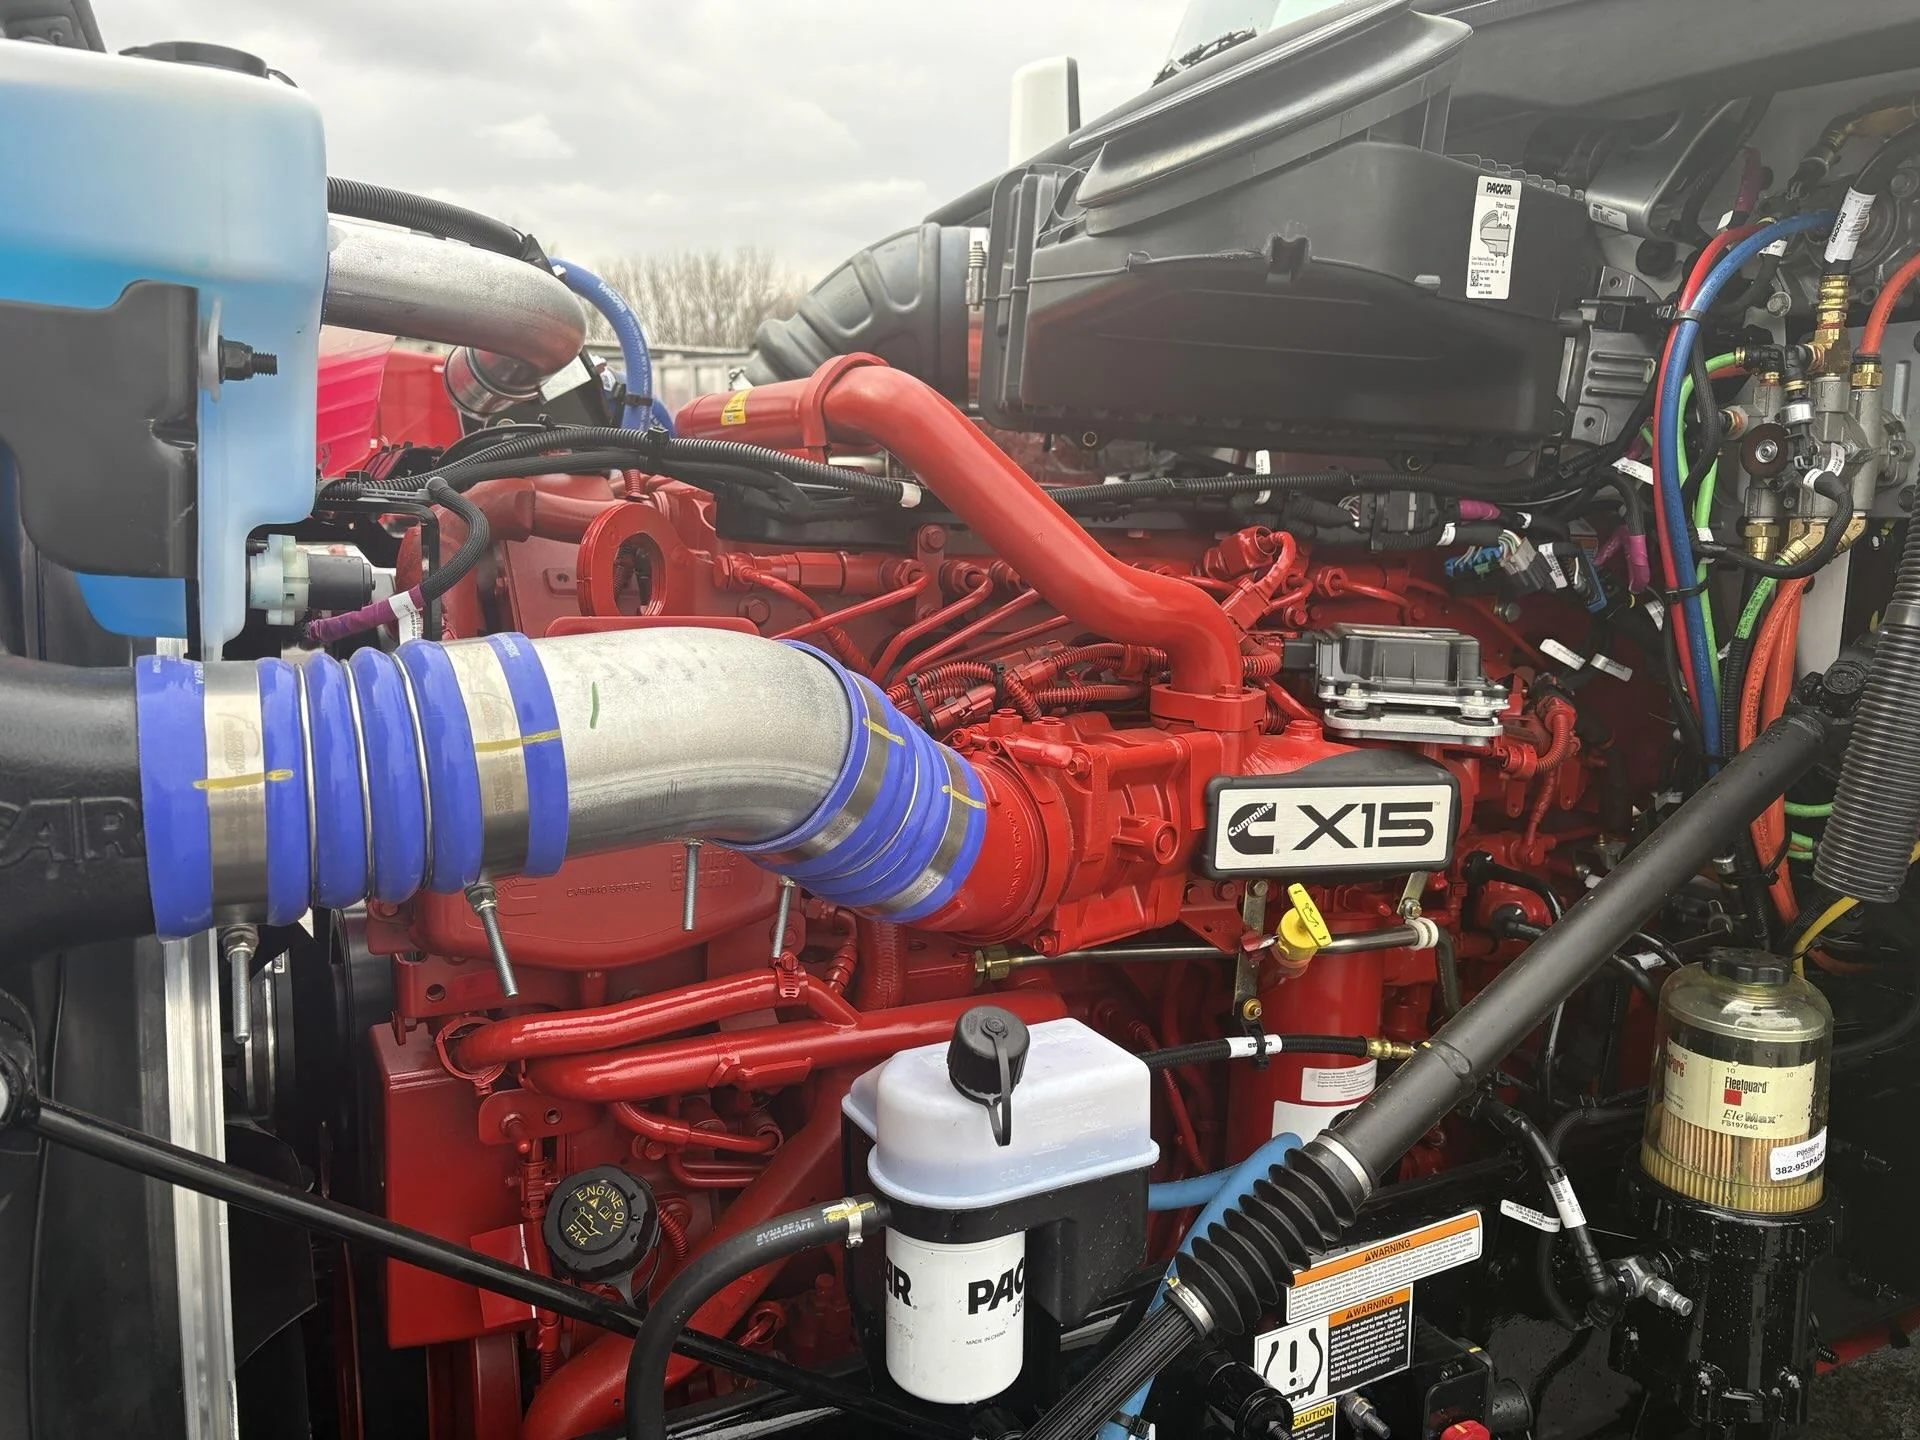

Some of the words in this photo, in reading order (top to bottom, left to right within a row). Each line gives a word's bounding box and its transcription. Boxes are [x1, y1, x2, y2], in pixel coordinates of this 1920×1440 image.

[1486, 182, 1512, 195] PACCAR
[1006, 809, 1023, 849] MADE
[1228, 802, 1274, 838] Cummins
[1292, 801, 1434, 851] X15
[1724, 1076, 1768, 1094] Fleetguard
[1723, 1109, 1744, 1122] Ele
[1745, 1112, 1776, 1124] Max
[576, 1186, 624, 1209] ENGINE
[610, 1212, 625, 1232] OIL
[566, 1224, 587, 1246] FA4
[1371, 1239, 1411, 1259] WARNING
[1353, 1296, 1394, 1317] WARNING
[966, 1338, 982, 1346] MADE
[991, 1330, 1006, 1341] CHINA
[1293, 1405, 1333, 1427] CAUTION
